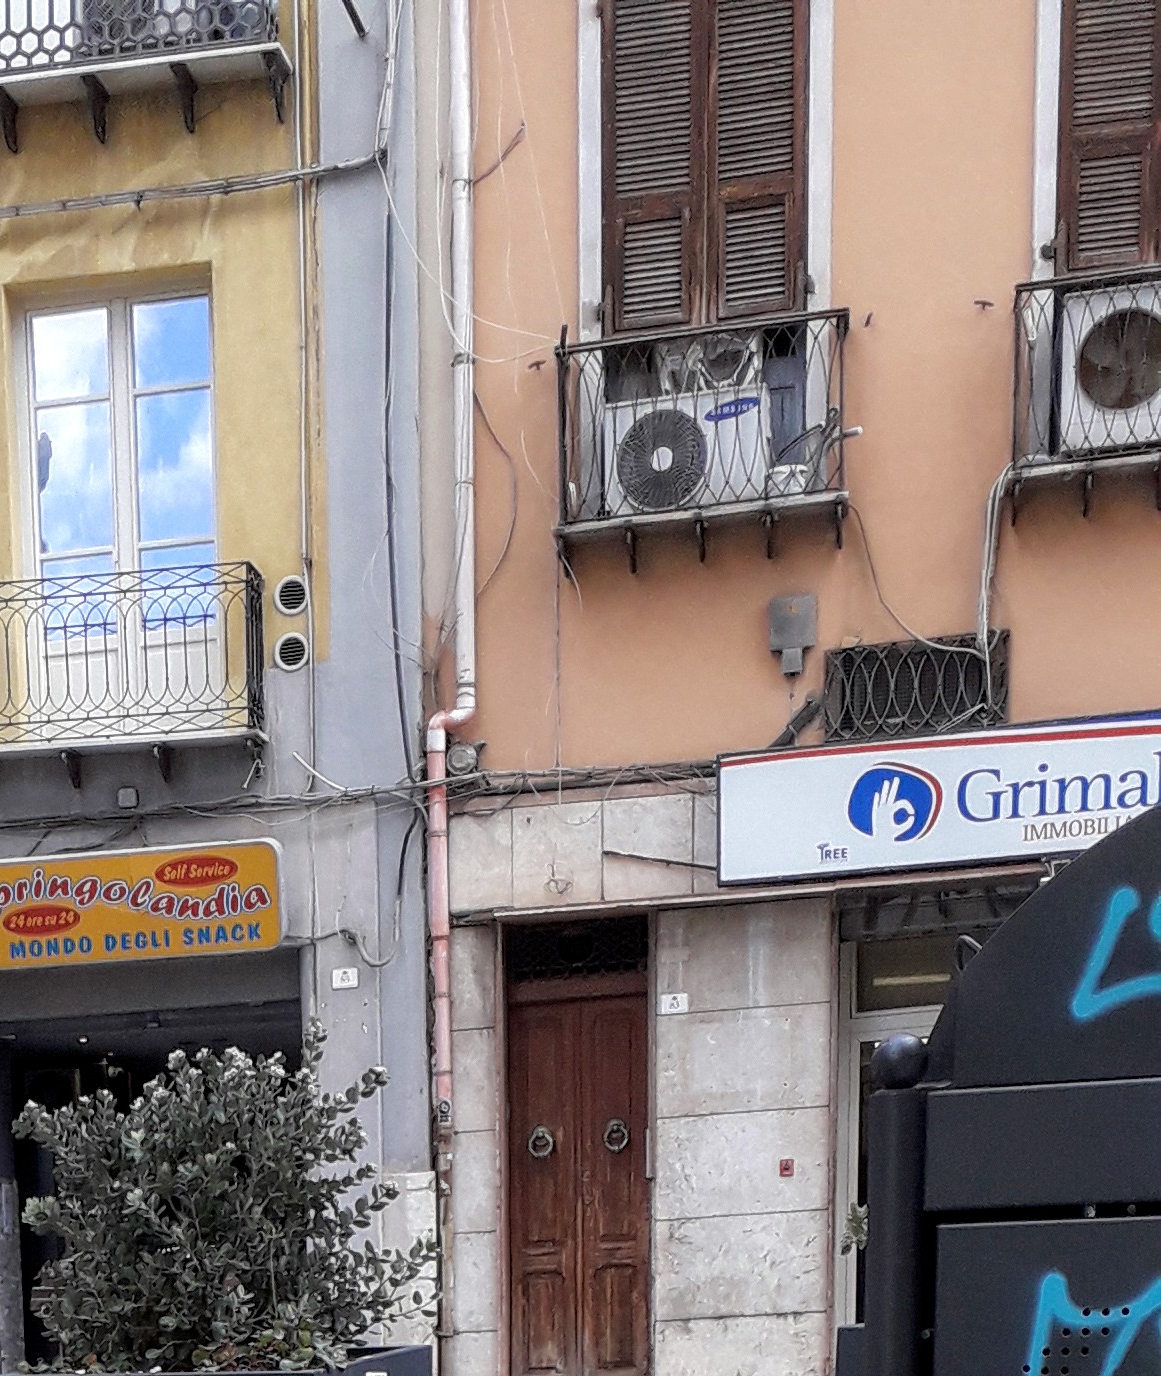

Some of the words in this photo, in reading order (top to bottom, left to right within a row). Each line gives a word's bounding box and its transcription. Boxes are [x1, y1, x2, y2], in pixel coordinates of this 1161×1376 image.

[816, 842, 848, 861] TREE
[163, 863, 186, 881] Self
[189, 861, 230, 879] Service
[9, 914, 25, 929] 24
[26, 916, 43, 928] ore
[45, 915, 57, 926] su
[58, 911, 75, 924] 24
[9, 936, 93, 960] MONDO
[105, 929, 170, 952] DEGLI
[183, 922, 261, 946] SNACK
